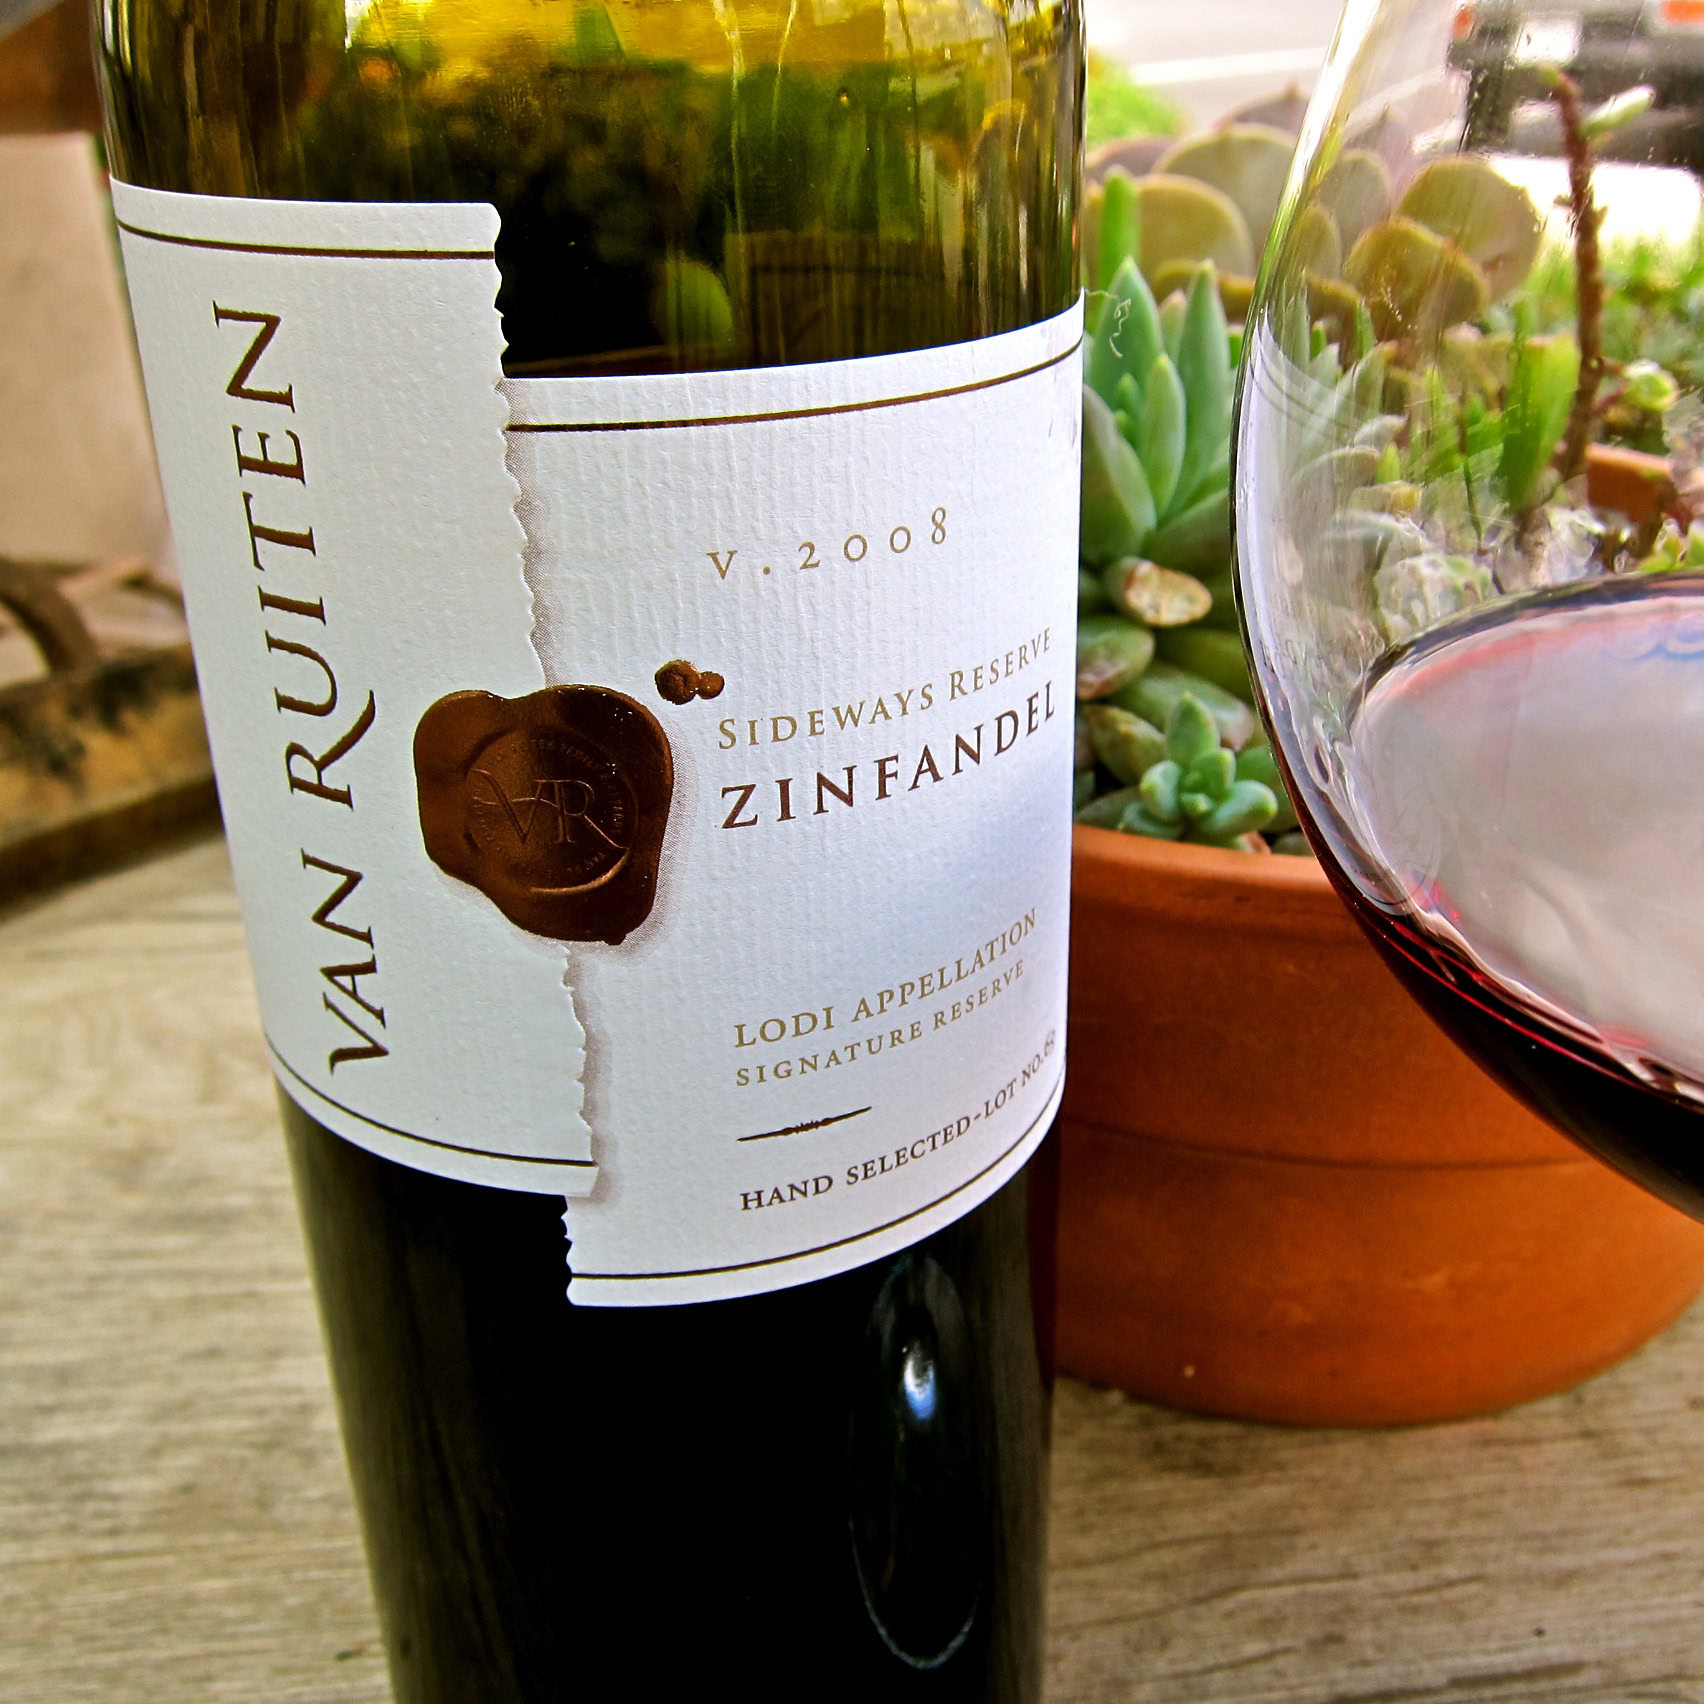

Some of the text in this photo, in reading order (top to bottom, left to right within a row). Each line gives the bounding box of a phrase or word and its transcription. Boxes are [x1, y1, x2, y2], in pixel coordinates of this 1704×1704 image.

[212, 299, 390, 1076] VAN RUITEN
[719, 626, 1051, 750] SIDEWAYS RESERVE
[721, 680, 1056, 829] ZINFANDEL
[734, 907, 1037, 1048] LODI APPELLATION
[736, 960, 1024, 1087] SIGNATURE RESERVE
[740, 1174, 834, 1212] HAND
